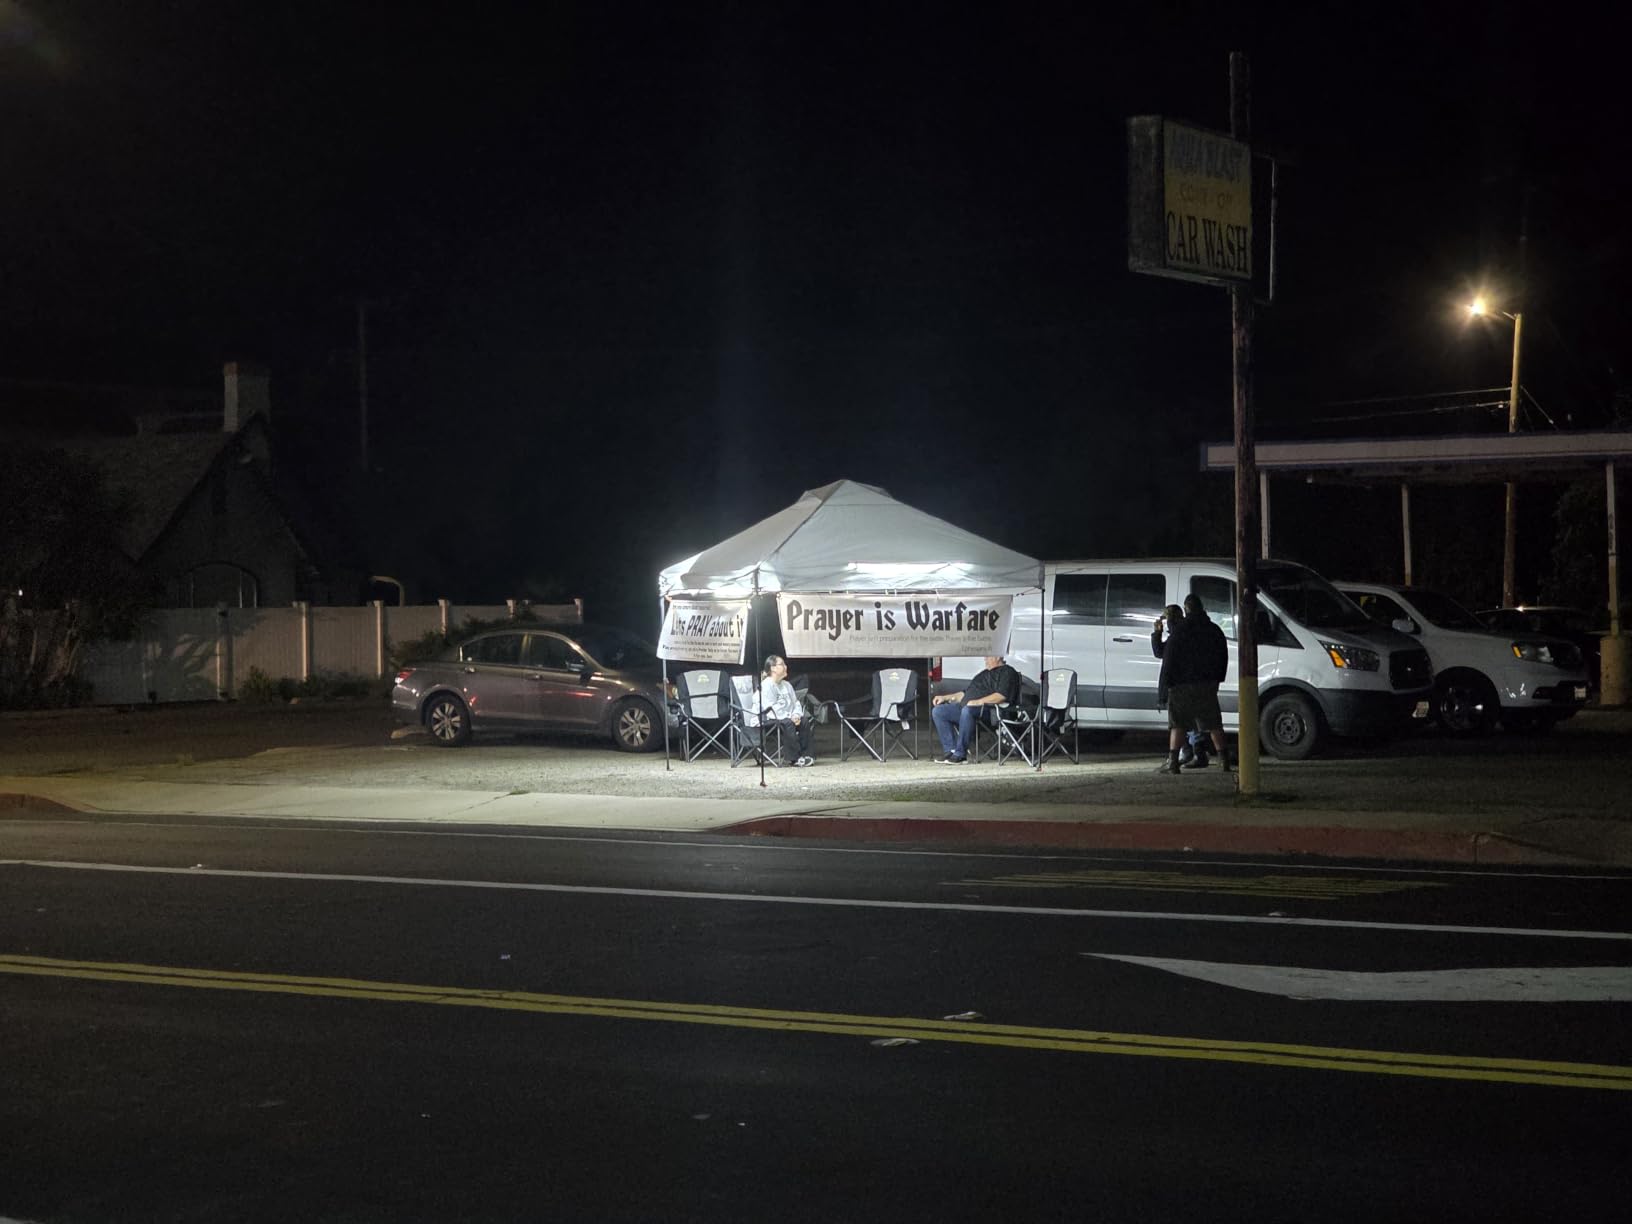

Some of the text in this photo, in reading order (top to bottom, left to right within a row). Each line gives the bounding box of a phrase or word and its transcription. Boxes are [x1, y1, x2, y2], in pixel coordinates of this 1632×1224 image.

[1167, 211, 1248, 272] CAR WASH
[686, 615, 711, 637] PRAY
[709, 615, 735, 637] about
[787, 600, 1000, 641] Prayer is Warfare
